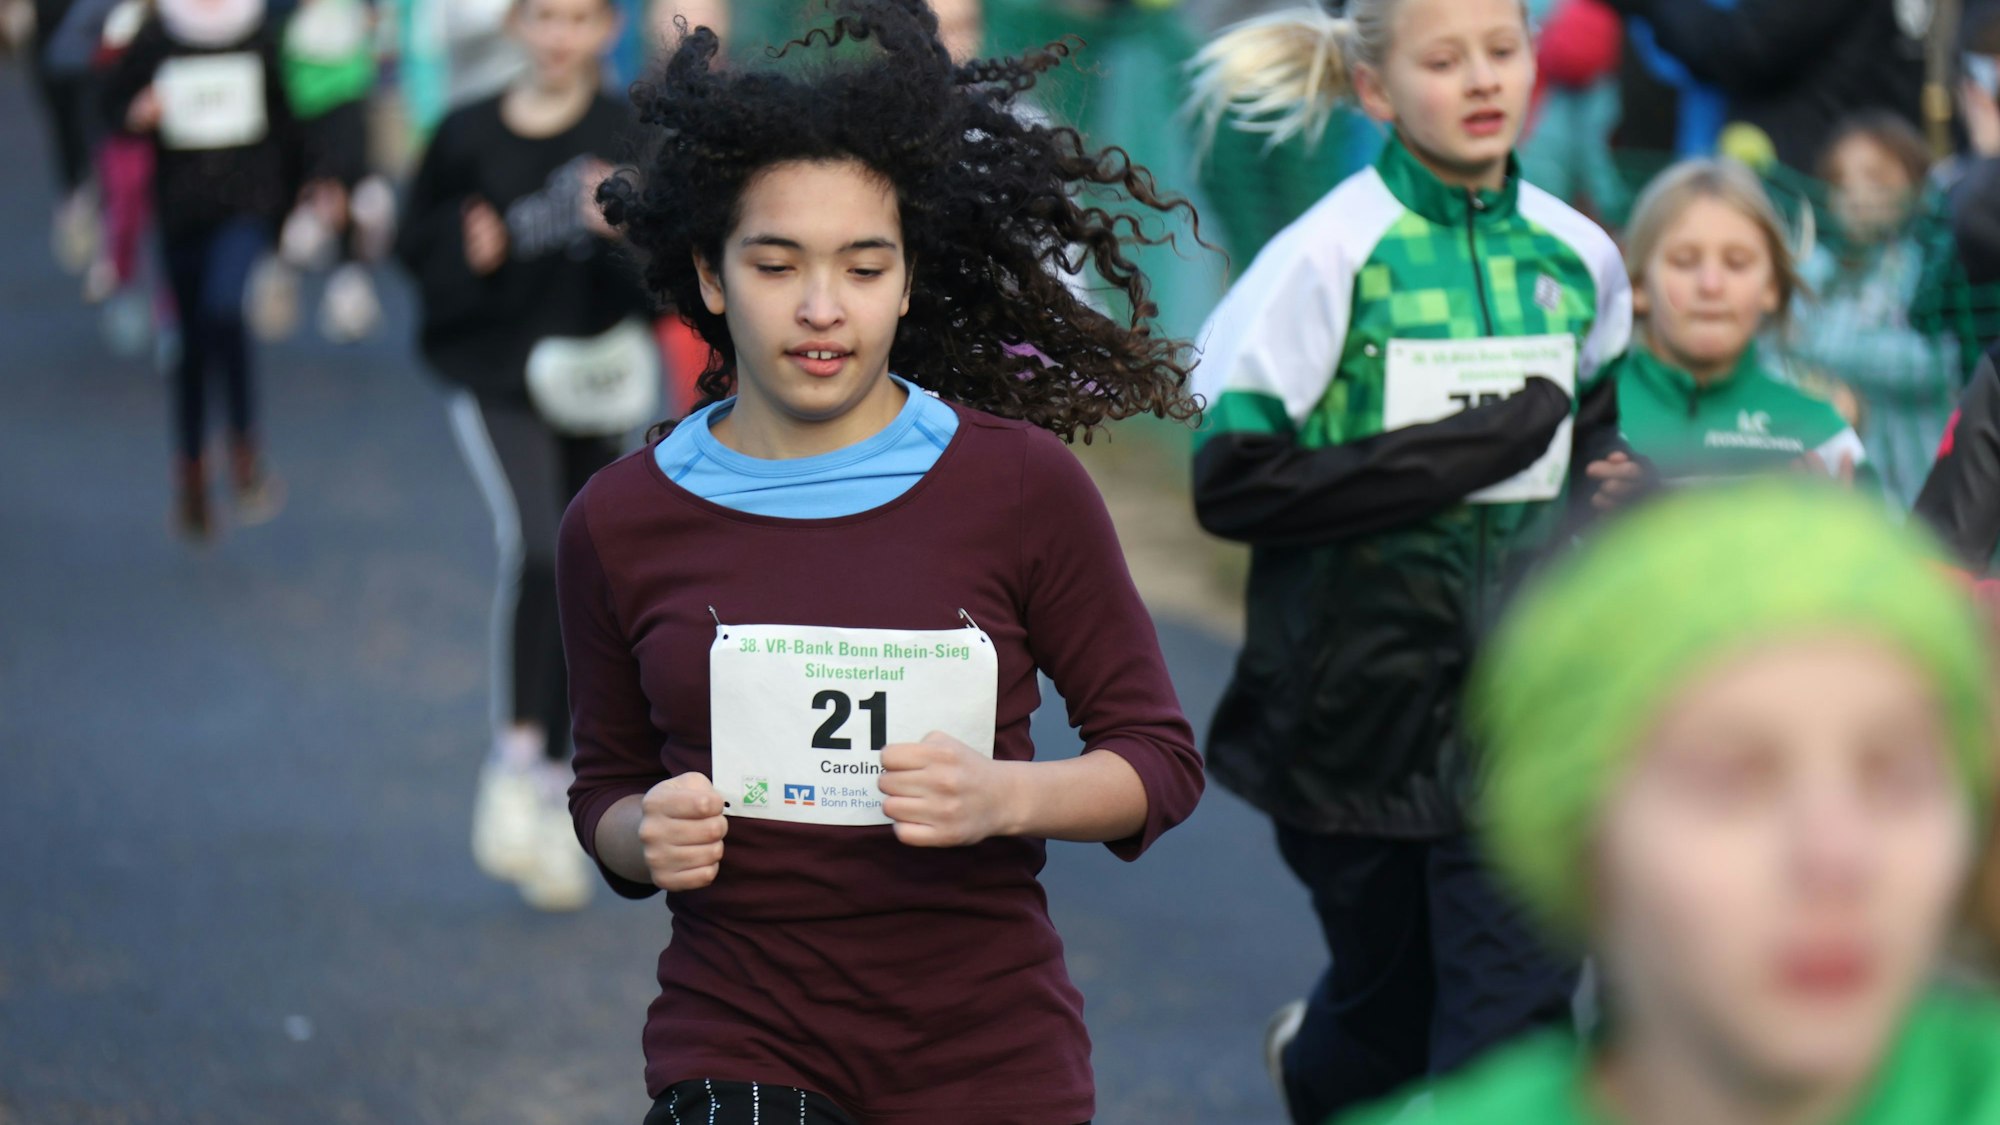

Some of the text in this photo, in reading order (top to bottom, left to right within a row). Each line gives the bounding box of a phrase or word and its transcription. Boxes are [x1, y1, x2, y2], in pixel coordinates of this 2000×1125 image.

[739, 638, 969, 660] 38. VR-Bank Bonn Rhein-Sieg
[805, 662, 904, 680] Silvesterlauf
[811, 689, 887, 750] 21
[821, 787, 868, 797] VR-Bank
[821, 797, 848, 807] Bonn
